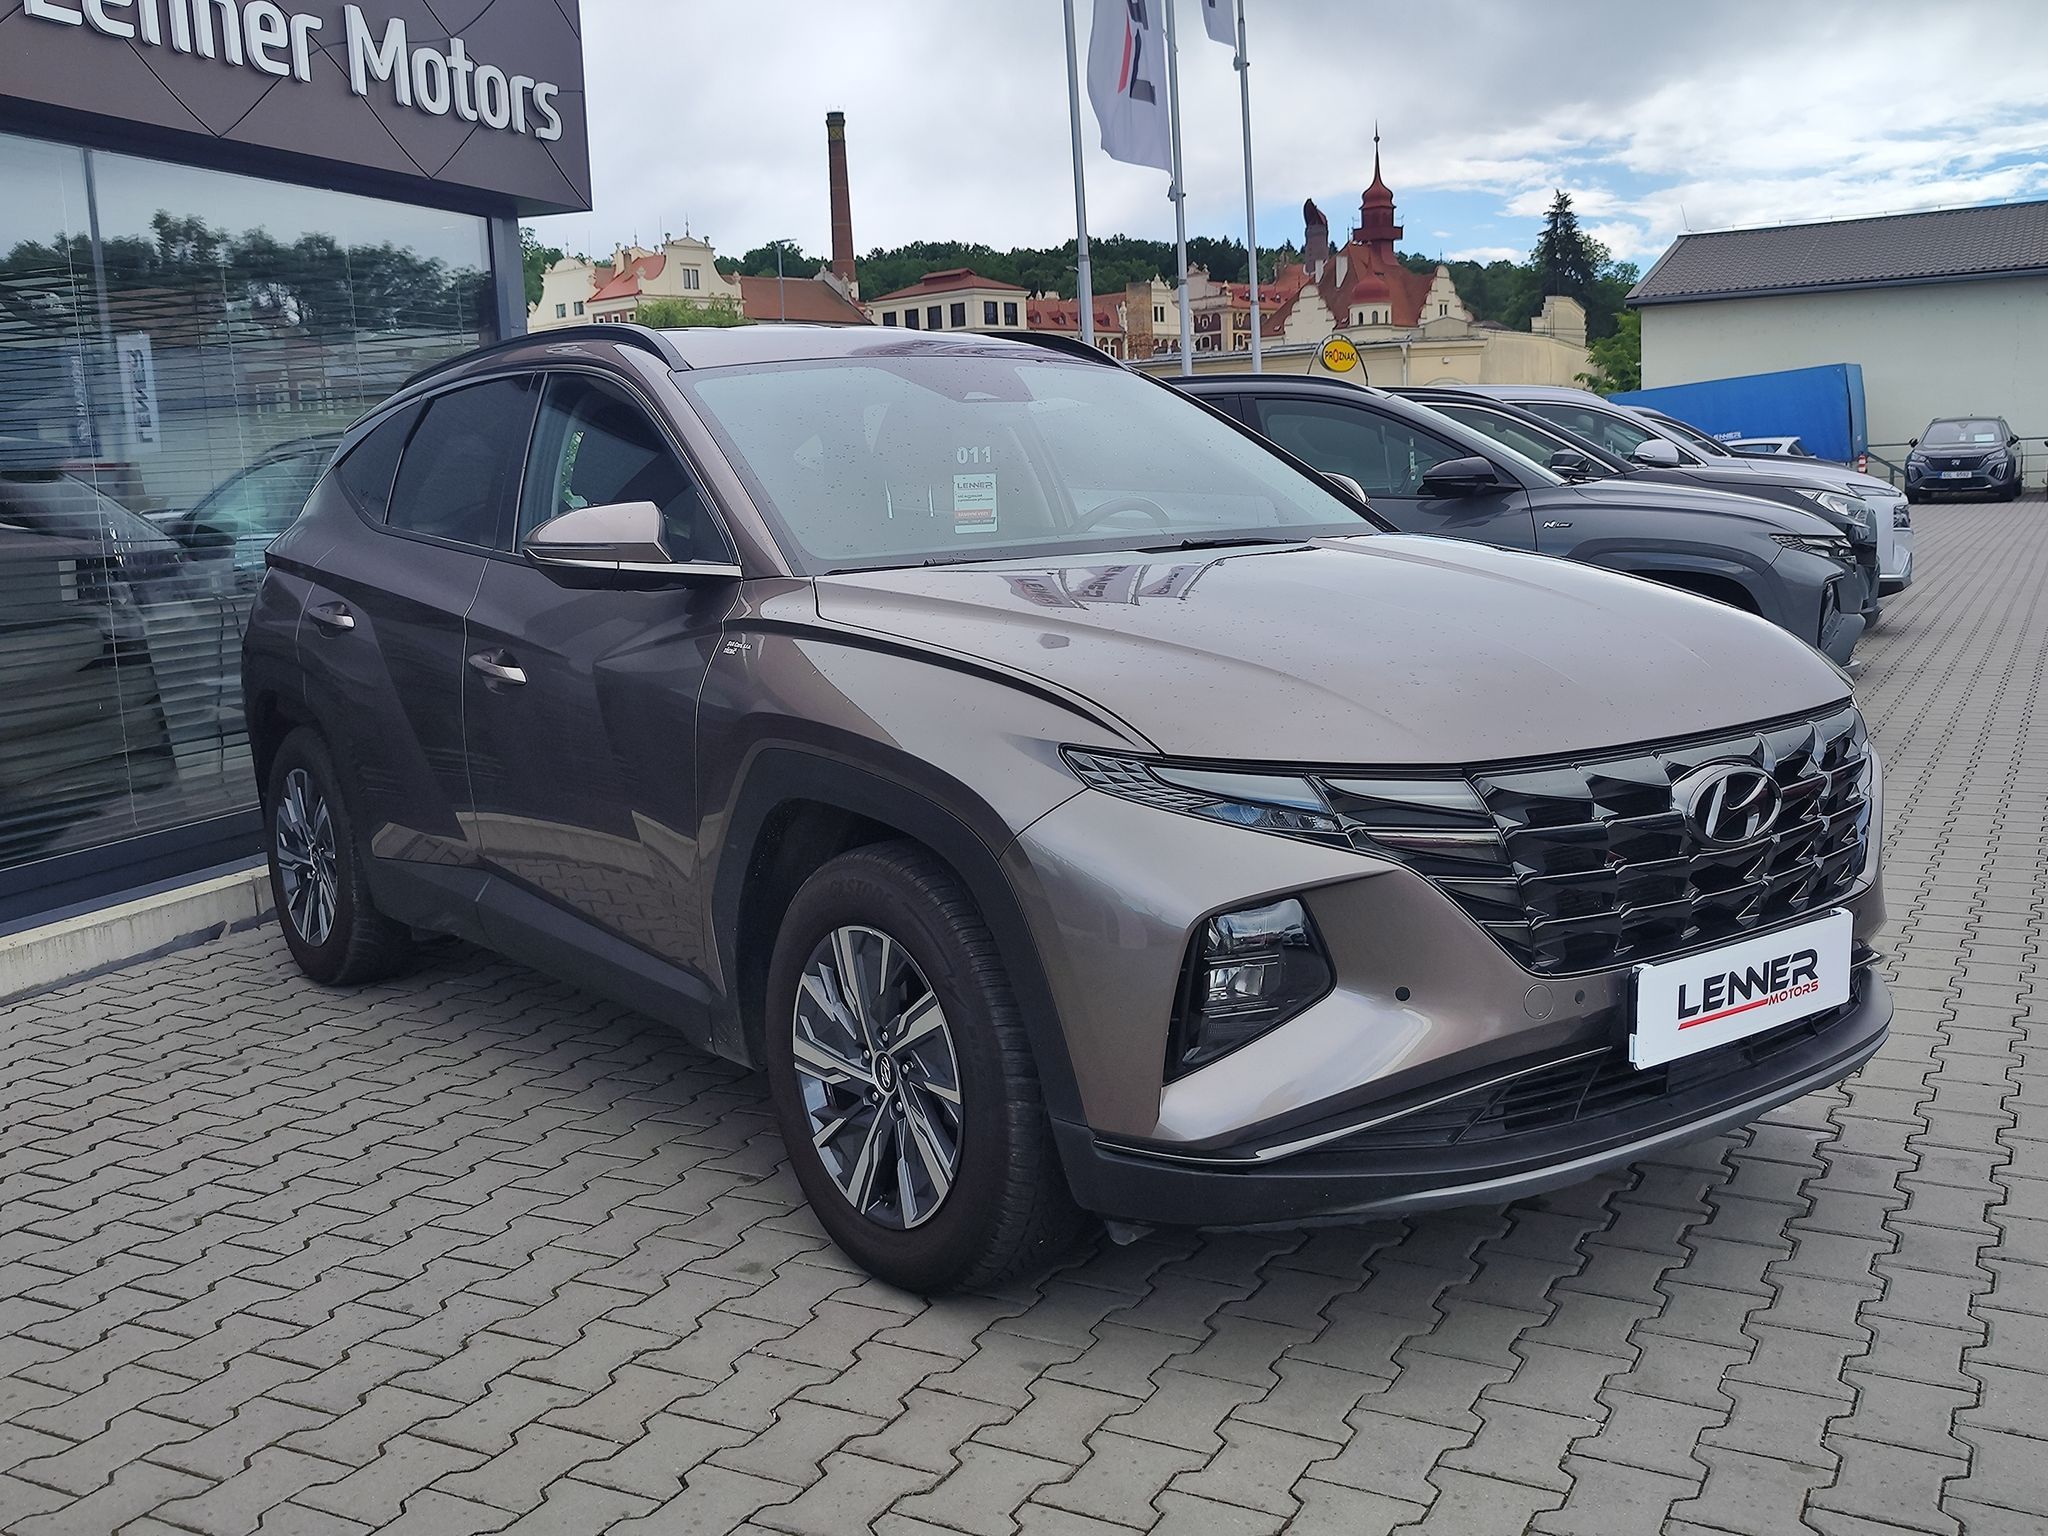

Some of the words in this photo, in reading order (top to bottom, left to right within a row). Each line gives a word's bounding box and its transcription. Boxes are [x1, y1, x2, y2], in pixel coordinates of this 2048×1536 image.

[344, 4, 563, 142] Motors
[956, 446, 991, 464] 011
[957, 481, 993, 489] LENNER
[1678, 948, 1819, 1020] LENNER
[1768, 980, 1819, 1006] MOTORS
